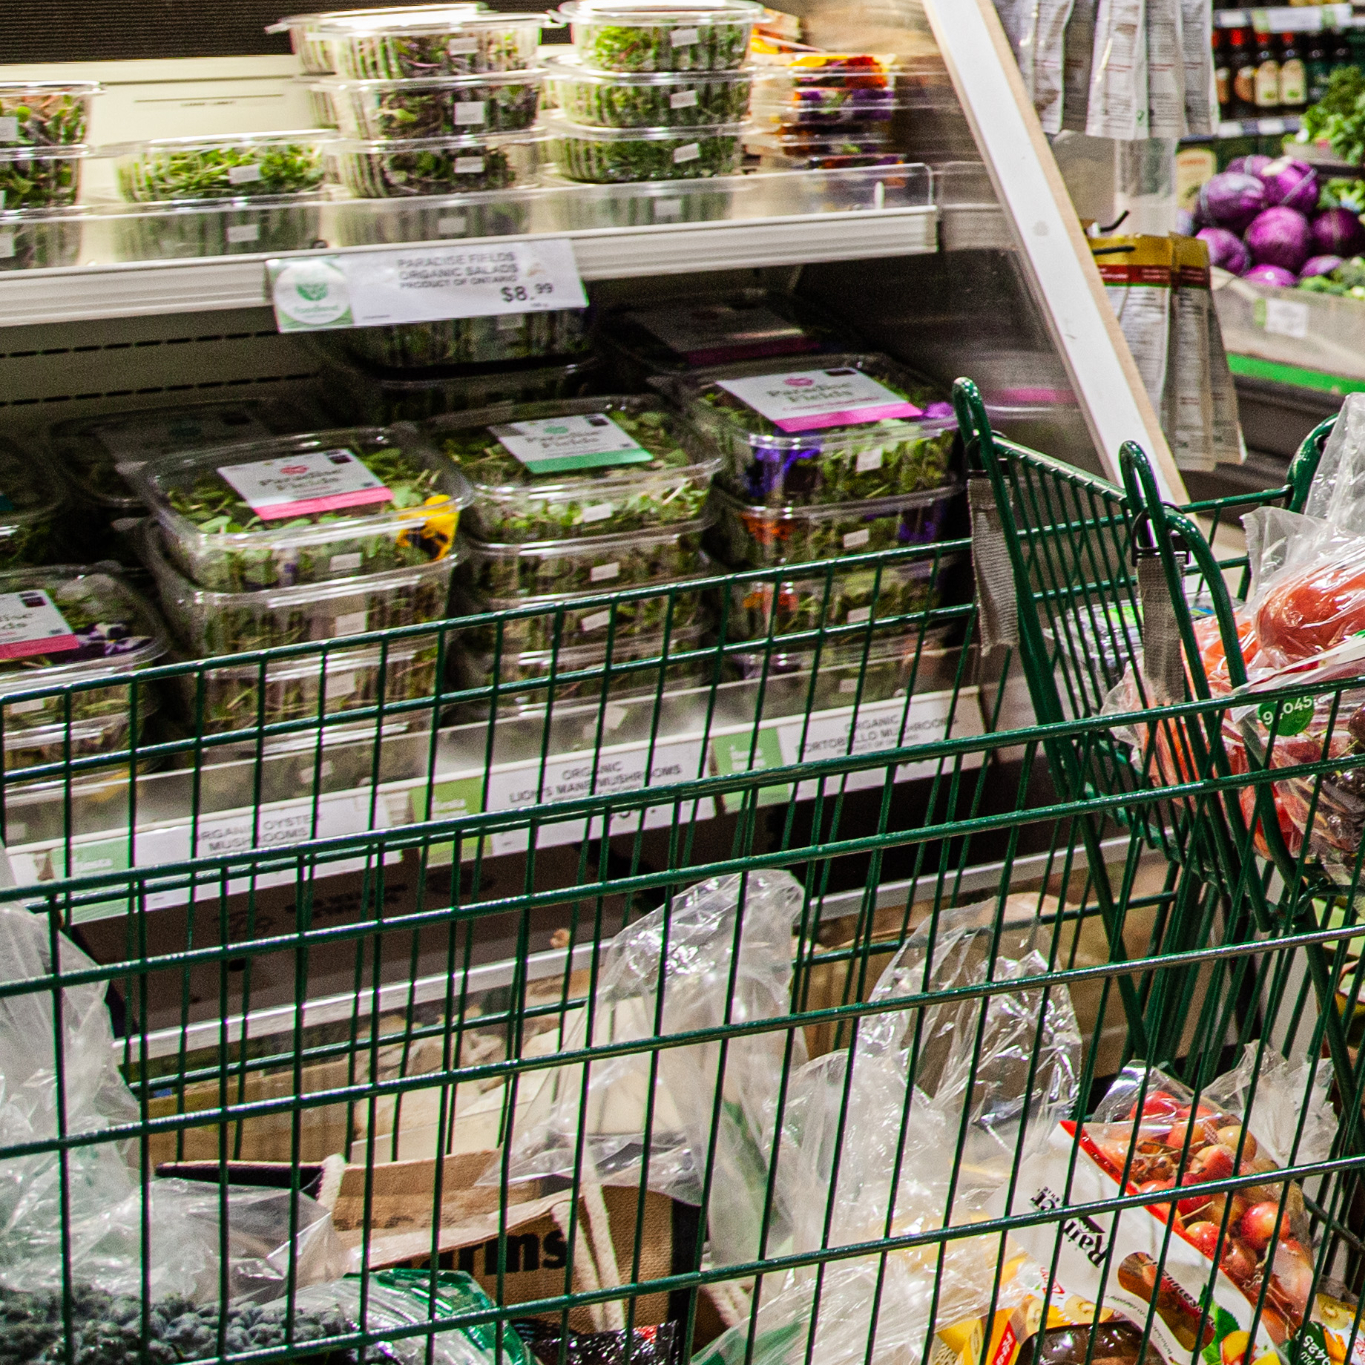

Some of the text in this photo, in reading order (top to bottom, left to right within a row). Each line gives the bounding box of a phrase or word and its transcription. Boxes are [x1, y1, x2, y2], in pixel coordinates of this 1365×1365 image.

[397, 251, 516, 268] PARADISE FIELDS
[398, 263, 519, 280] ORGANIC SALADS
[500, 283, 554, 304] $8.99
[1262, 695, 1314, 726] 9045
[562, 760, 623, 781] ORGNIC
[596, 764, 683, 788] MUSHROMS
[263, 811, 324, 831] OYSTE
[208, 828, 310, 853] MUSHOOMS
